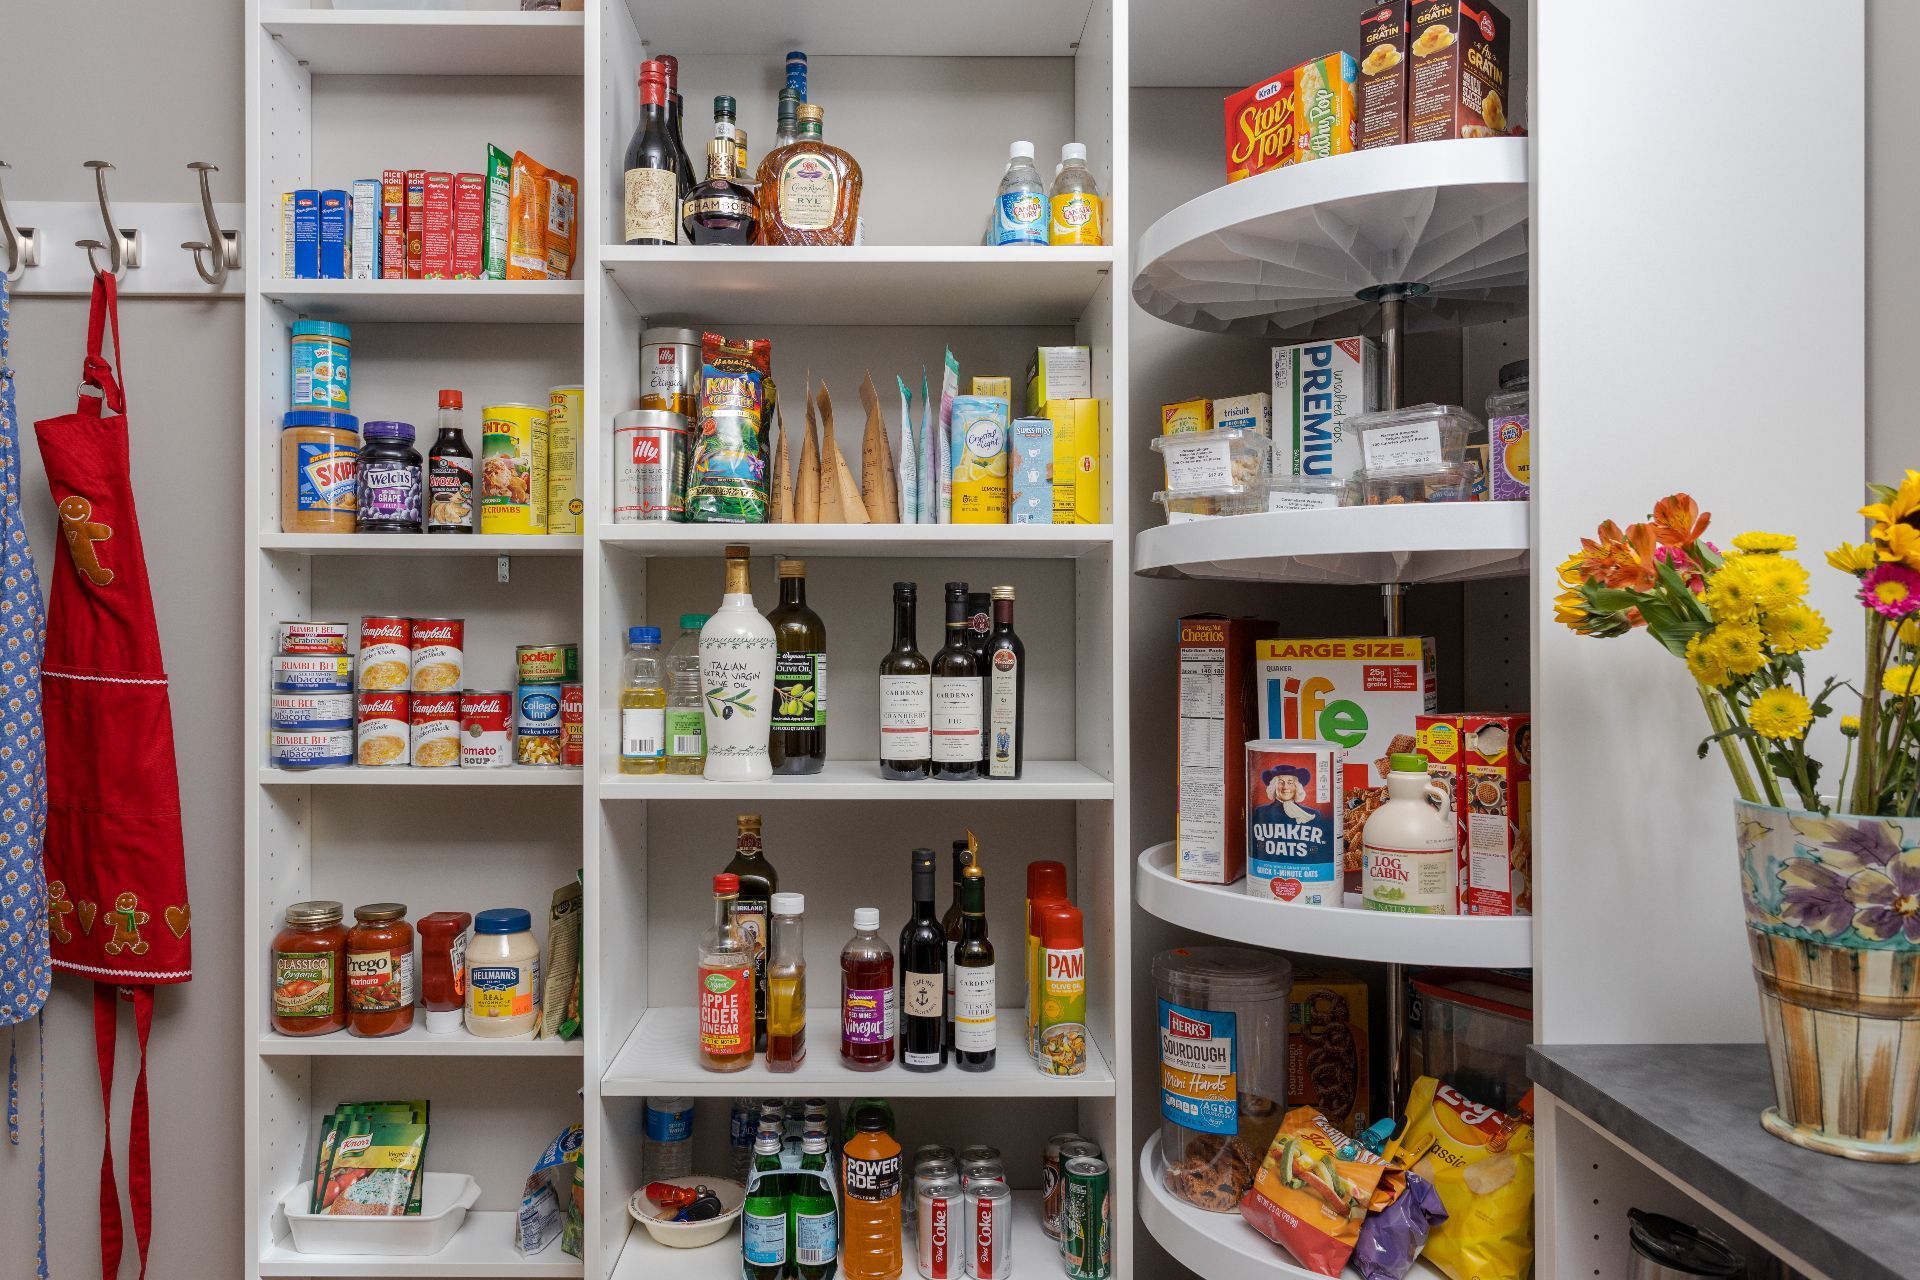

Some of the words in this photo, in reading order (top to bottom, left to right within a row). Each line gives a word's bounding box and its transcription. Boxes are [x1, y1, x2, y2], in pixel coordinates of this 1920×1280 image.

[1417, 6, 1452, 23] GRATIN
[1367, 26, 1399, 42] GRATIN
[1467, 48, 1503, 85] GRATIN
[1259, 85, 1278, 98] Kraft
[1310, 89, 1334, 122] Pop
[1254, 123, 1293, 169] Top
[660, 349, 674, 361] illy
[706, 377, 757, 401] KONA
[1333, 370, 1347, 416] unsalted
[1224, 406, 1250, 418] triscuit
[968, 429, 997, 444] Crystal
[1333, 420, 1343, 443] tops
[632, 440, 659, 463] illy
[370, 472, 410, 485] Welch's
[378, 494, 402, 503] GRAPE
[361, 623, 403, 638] Campbell's
[412, 625, 454, 640] Campbell's
[1181, 628, 1225, 642] Cheerios
[1270, 643, 1346, 658] LARGE
[1353, 643, 1405, 658] SIZE
[709, 661, 748, 671] ITALIAN
[1266, 665, 1293, 673] QUAKER
[1369, 668, 1386, 678] 25g
[286, 674, 332, 683] Albacore
[704, 670, 727, 679] EXTRA
[731, 671, 761, 682] VIRGIN
[707, 679, 728, 688] OLIVE
[412, 701, 457, 716] Campbell's
[522, 700, 557, 712] College
[1267, 676, 1368, 749] life
[274, 712, 311, 721] Albacore
[531, 710, 547, 718] Inn
[276, 736, 307, 745] BUMBLE
[311, 736, 328, 745] BEE
[280, 750, 325, 758] Albacore
[1254, 823, 1324, 845] QUAKER
[1265, 839, 1309, 858] OATS
[1374, 856, 1402, 870] LOG
[1256, 866, 1272, 875] QUICK
[1274, 868, 1303, 877] 1-MINUTE
[1304, 870, 1319, 878] OATS
[1370, 866, 1410, 882] CABIN
[277, 958, 328, 971] CLASSICO
[347, 956, 388, 976] Prego
[1047, 953, 1084, 979] PAM
[284, 971, 319, 979] Organic
[350, 978, 379, 986] Marinara
[473, 969, 517, 980] HELLMANN'S
[483, 993, 504, 1001] REAL
[702, 992, 739, 1009] APPLE
[702, 1006, 739, 1024] CIDER
[702, 1021, 739, 1035] VINEGAR
[845, 1018, 884, 1037] Vinegar
[1172, 1018, 1206, 1037] HERR'S
[1163, 1036, 1226, 1063] SOURDOUGH
[1176, 1057, 1206, 1070] PRETZELS
[1288, 1043, 1298, 1096] Sourdough
[1188, 1072, 1228, 1094] Hards
[1203, 1101, 1233, 1115] AGED
[343, 1137, 370, 1149] Knorr
[847, 1157, 899, 1175] POWER
[847, 1172, 877, 1189] ADE
[932, 1210, 947, 1247] Coke
[977, 1210, 993, 1247] Coke
[935, 1246, 944, 1263] Diet
[980, 1246, 989, 1263] Diet
